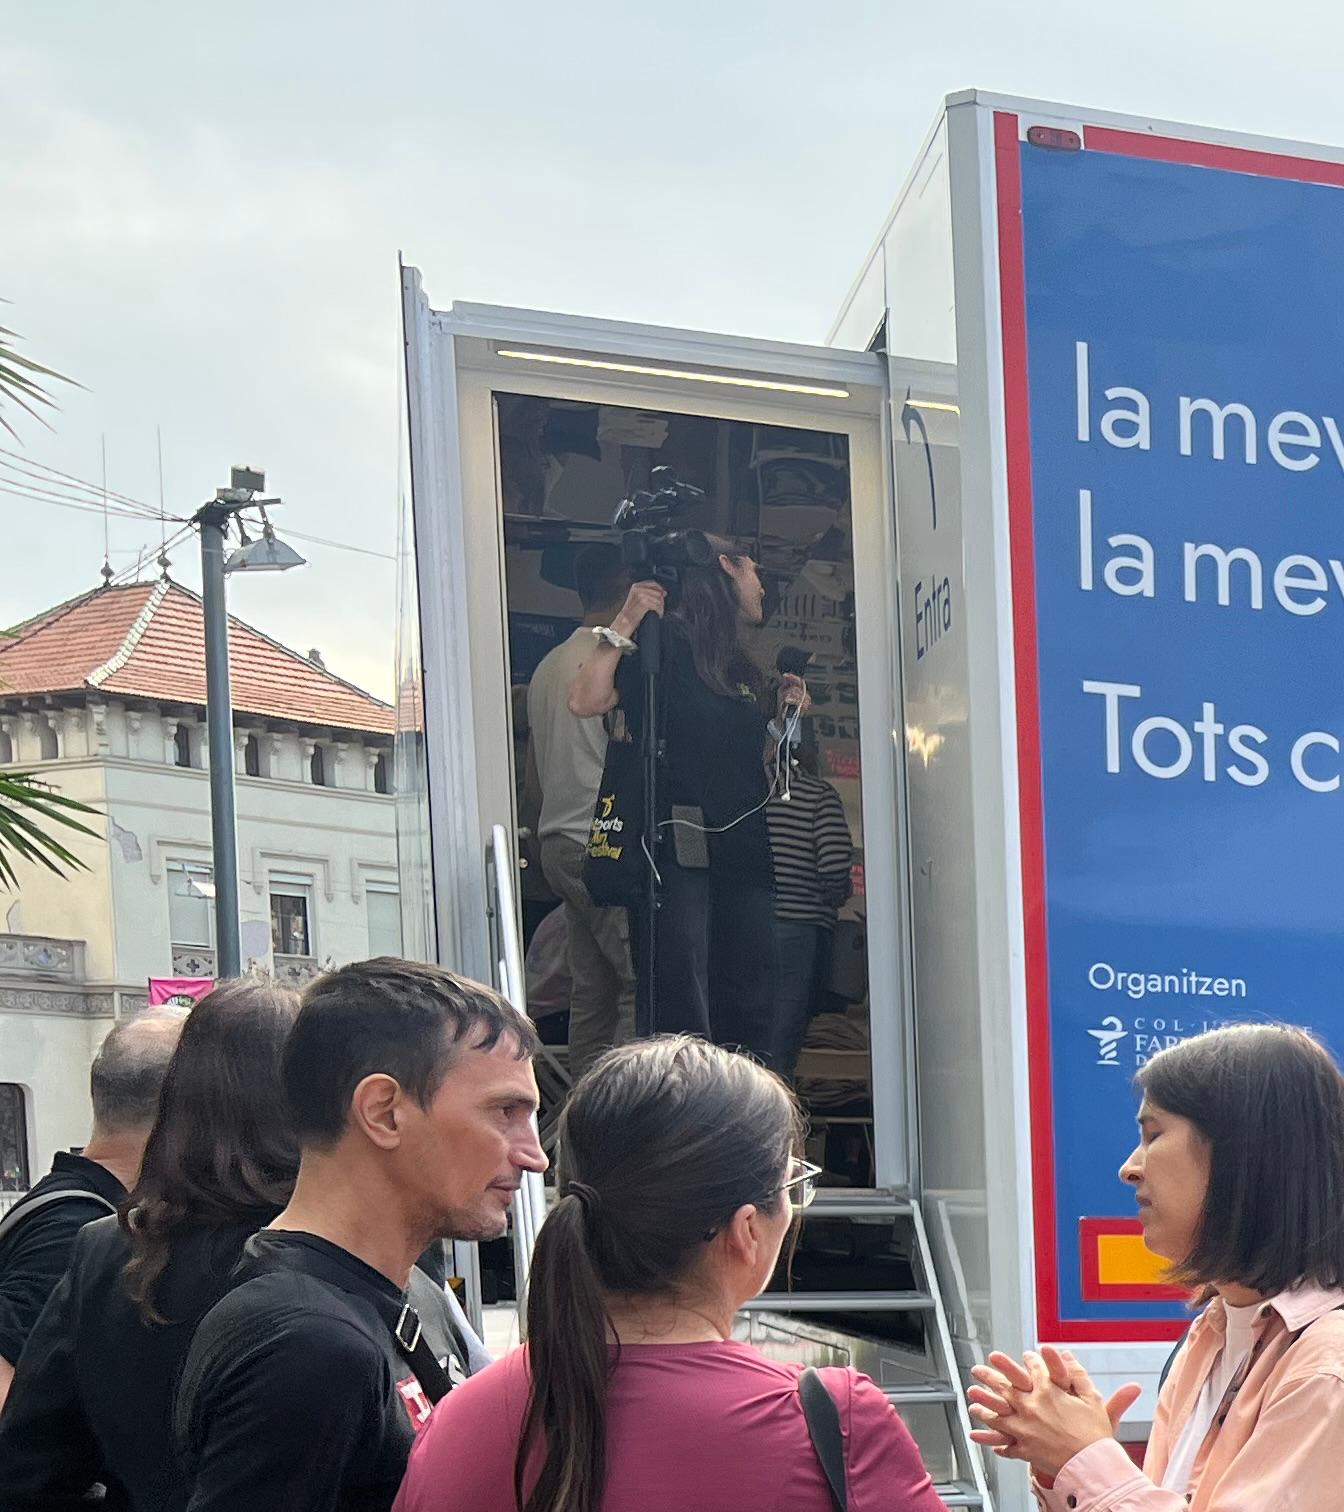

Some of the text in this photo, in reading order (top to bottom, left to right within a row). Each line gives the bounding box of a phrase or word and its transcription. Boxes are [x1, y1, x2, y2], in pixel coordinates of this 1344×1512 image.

[1074, 340, 1152, 452] la
[1078, 488, 1155, 597] la
[914, 574, 951, 660] Entra
[1082, 679, 1270, 786] Tots
[1088, 962, 1247, 999] Organitzen
